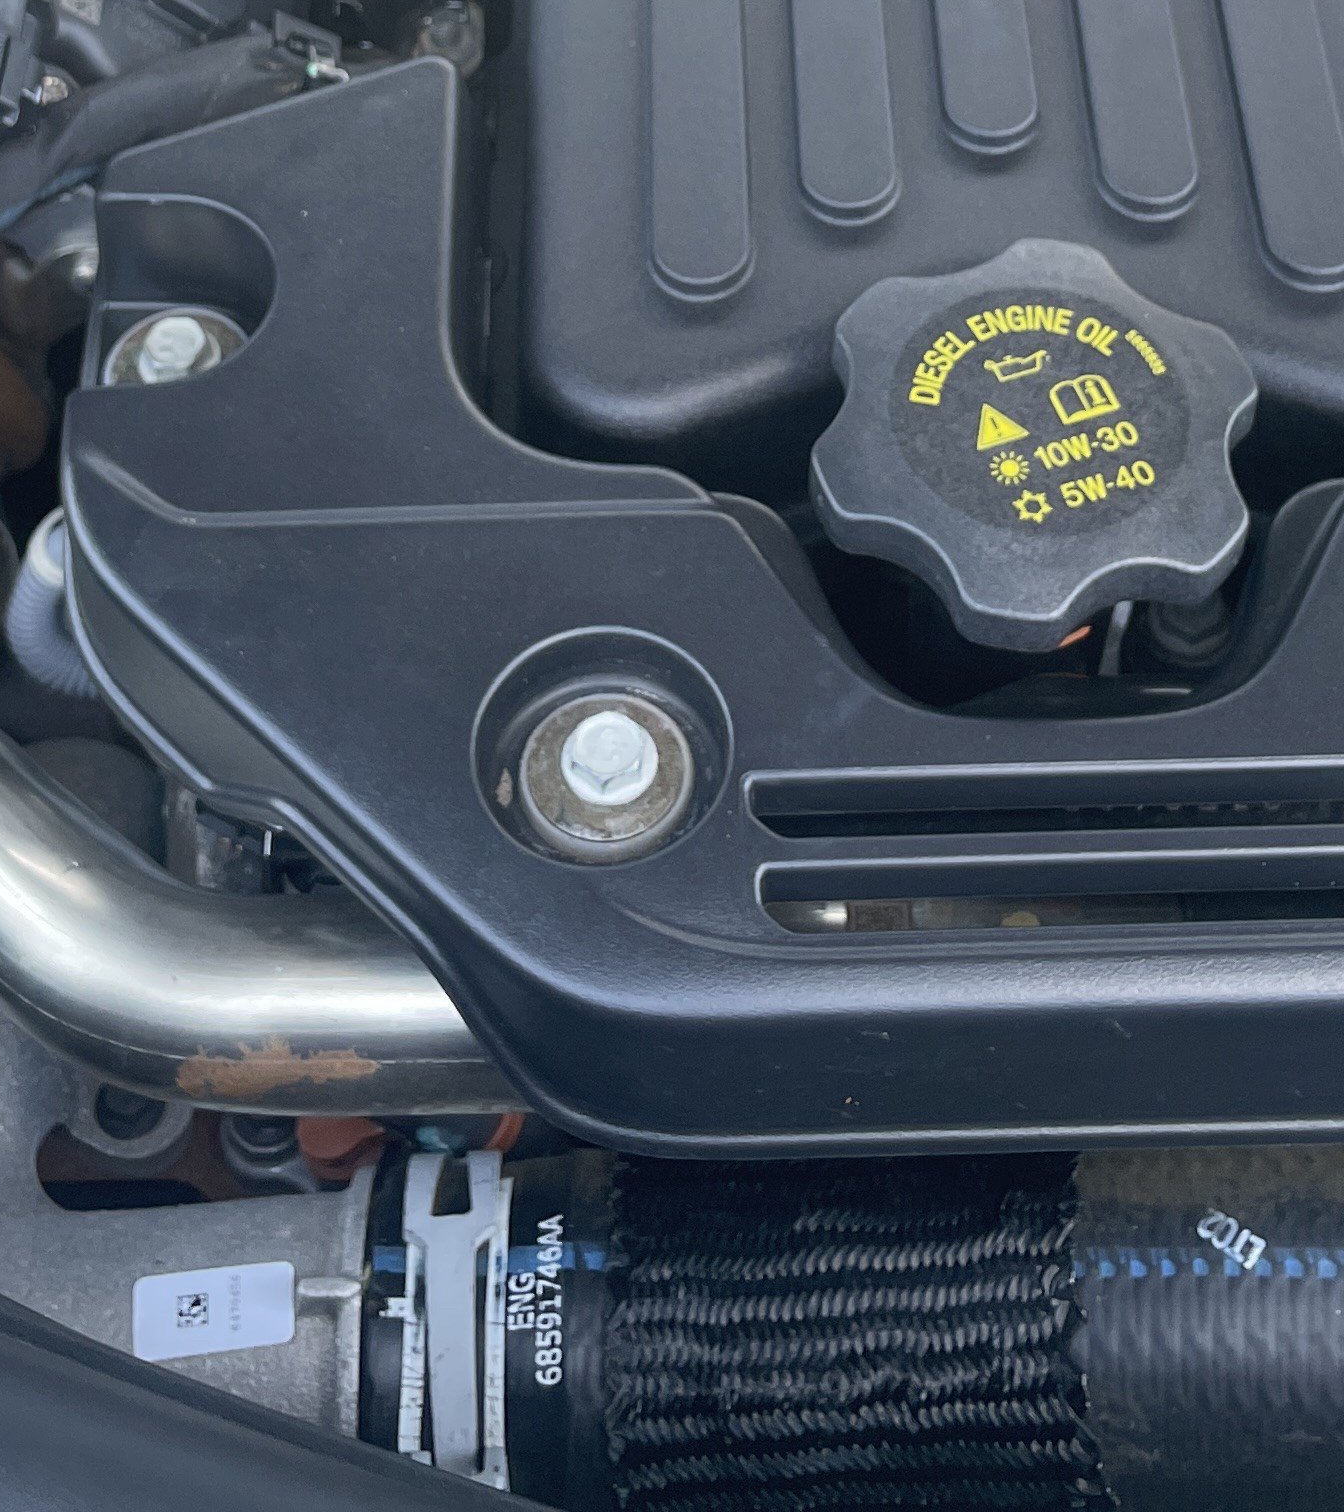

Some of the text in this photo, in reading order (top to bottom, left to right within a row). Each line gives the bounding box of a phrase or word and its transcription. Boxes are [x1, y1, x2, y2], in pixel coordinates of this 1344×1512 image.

[908, 330, 975, 406] DIESEL
[966, 305, 1074, 342] ENGINE
[1076, 316, 1120, 357] OIL
[1033, 421, 1140, 472] 10W-30
[1059, 460, 1156, 510] 5W-40
[507, 1271, 536, 1331] ENG
[534, 1213, 564, 1386] 68591746AA
